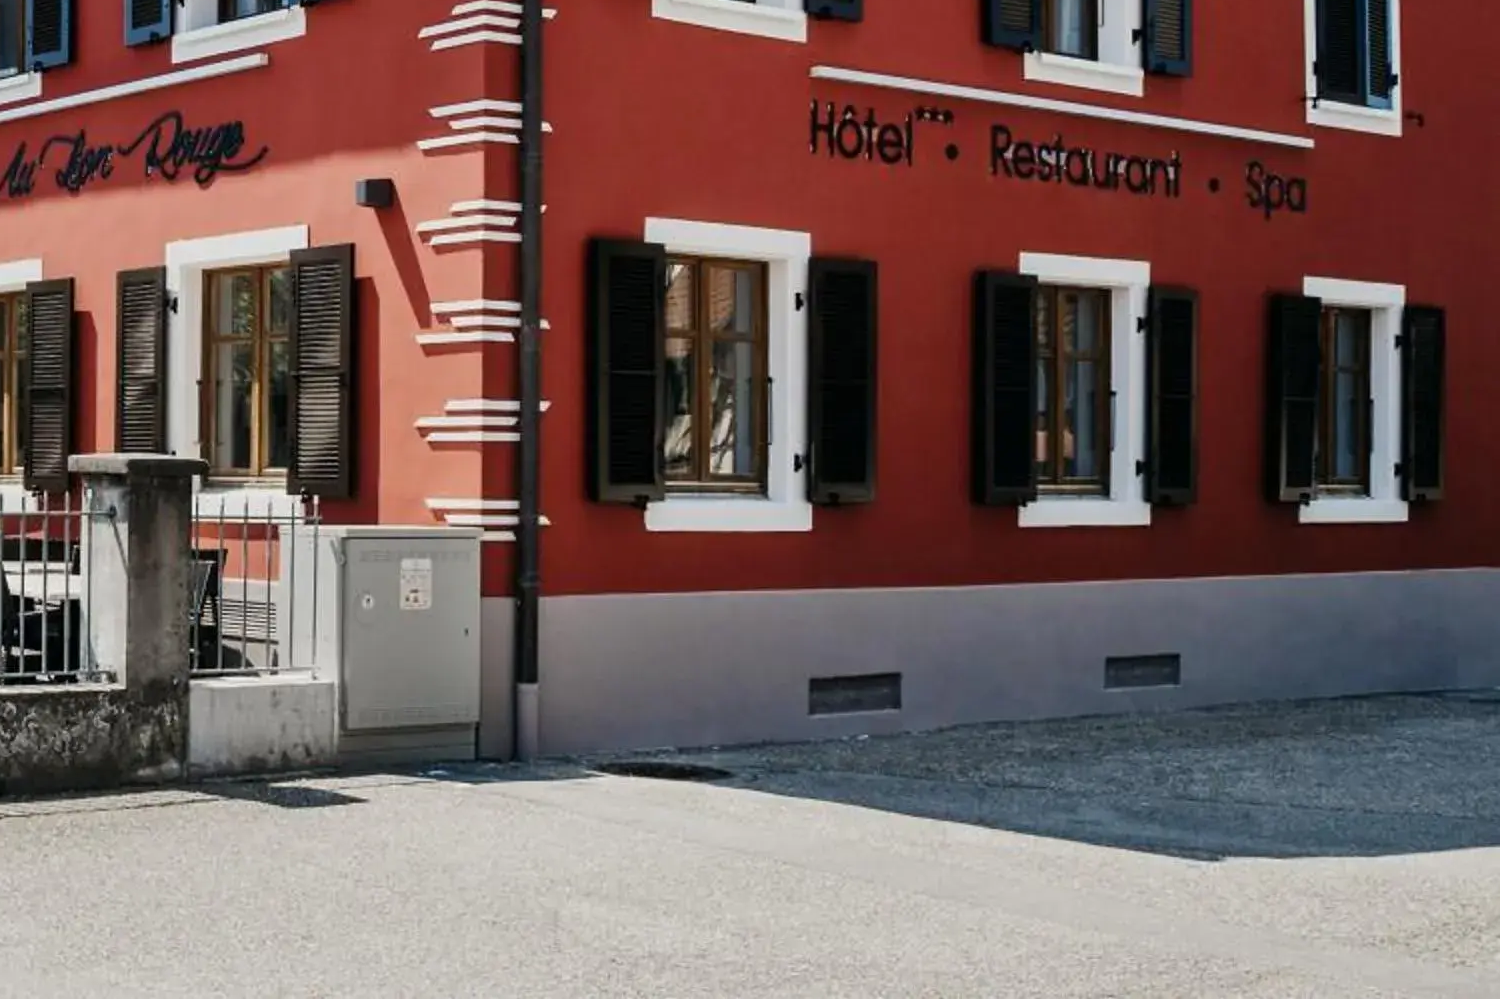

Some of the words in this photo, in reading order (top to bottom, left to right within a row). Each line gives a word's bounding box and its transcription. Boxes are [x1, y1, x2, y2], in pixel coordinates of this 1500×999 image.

[119, 109, 270, 189] Rouge
[990, 125, 1182, 196] Restaurant
[1246, 160, 1307, 220] Spa
